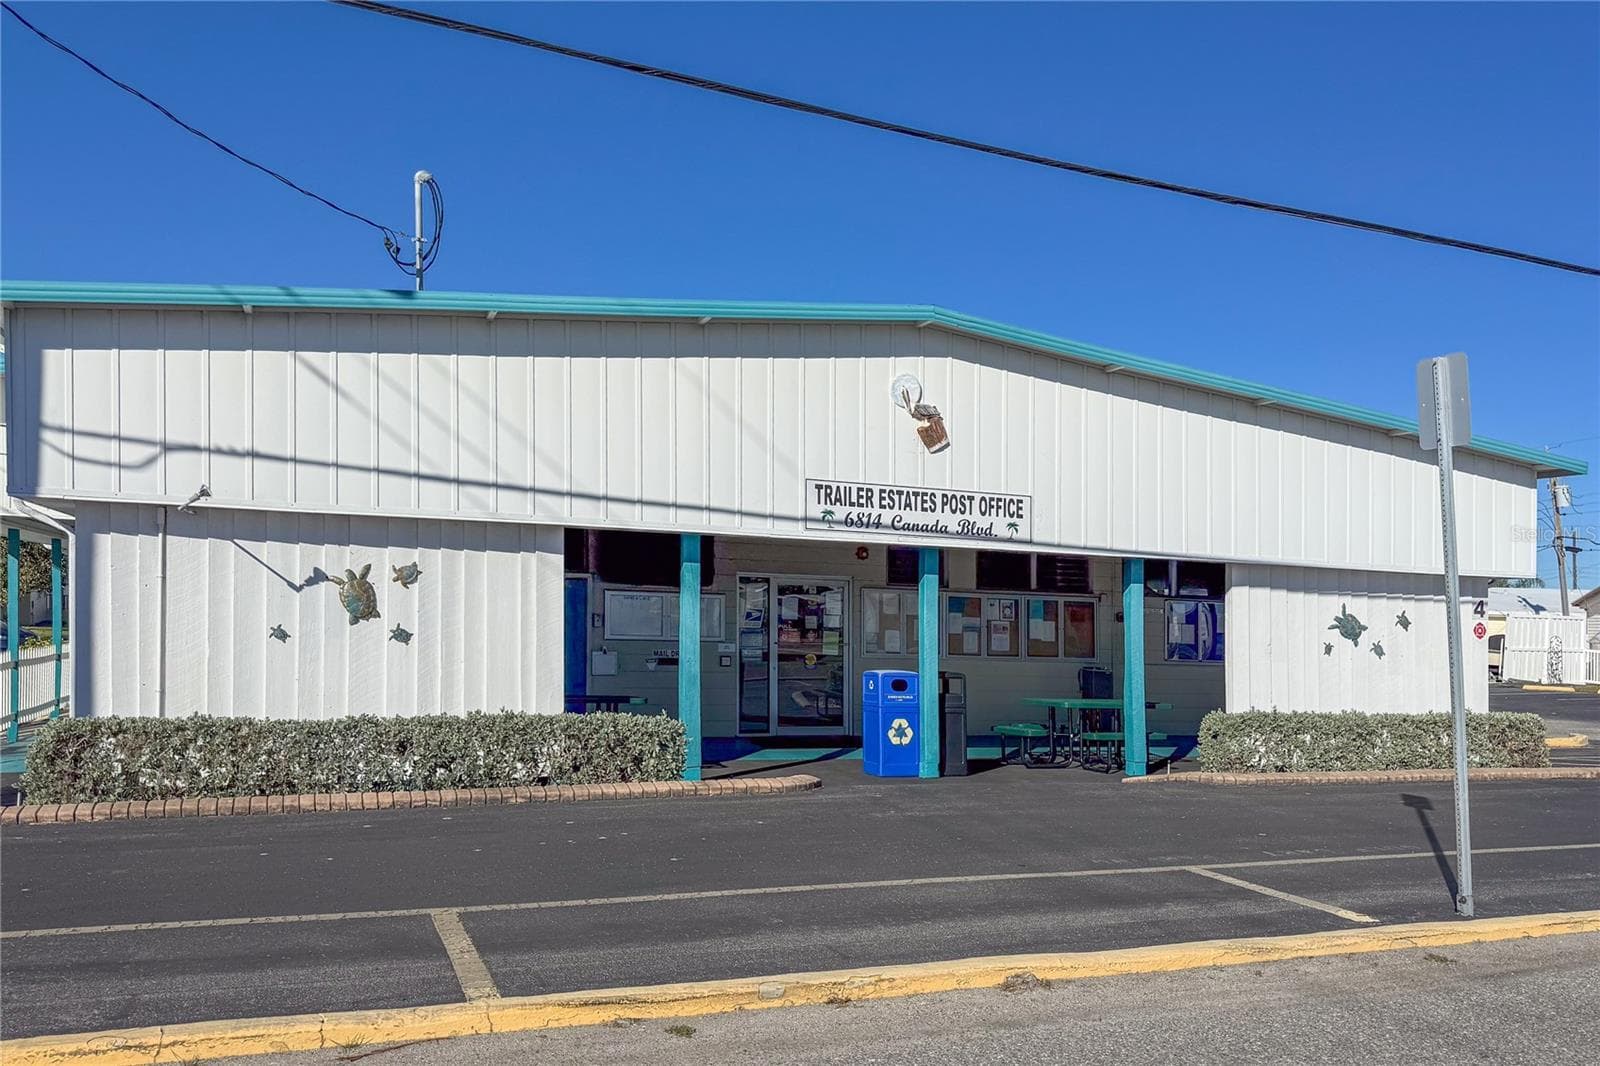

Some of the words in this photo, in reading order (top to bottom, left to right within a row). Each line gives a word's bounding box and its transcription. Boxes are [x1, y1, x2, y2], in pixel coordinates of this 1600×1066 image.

[815, 484, 874, 509] TRAILER
[879, 488, 937, 513] ESTATES
[942, 493, 975, 516] POST
[979, 496, 1024, 519] OFFICE
[844, 511, 882, 529] 6814
[891, 514, 949, 534] Canada
[956, 518, 999, 538] Blvd.
[1473, 600, 1486, 618] 4
